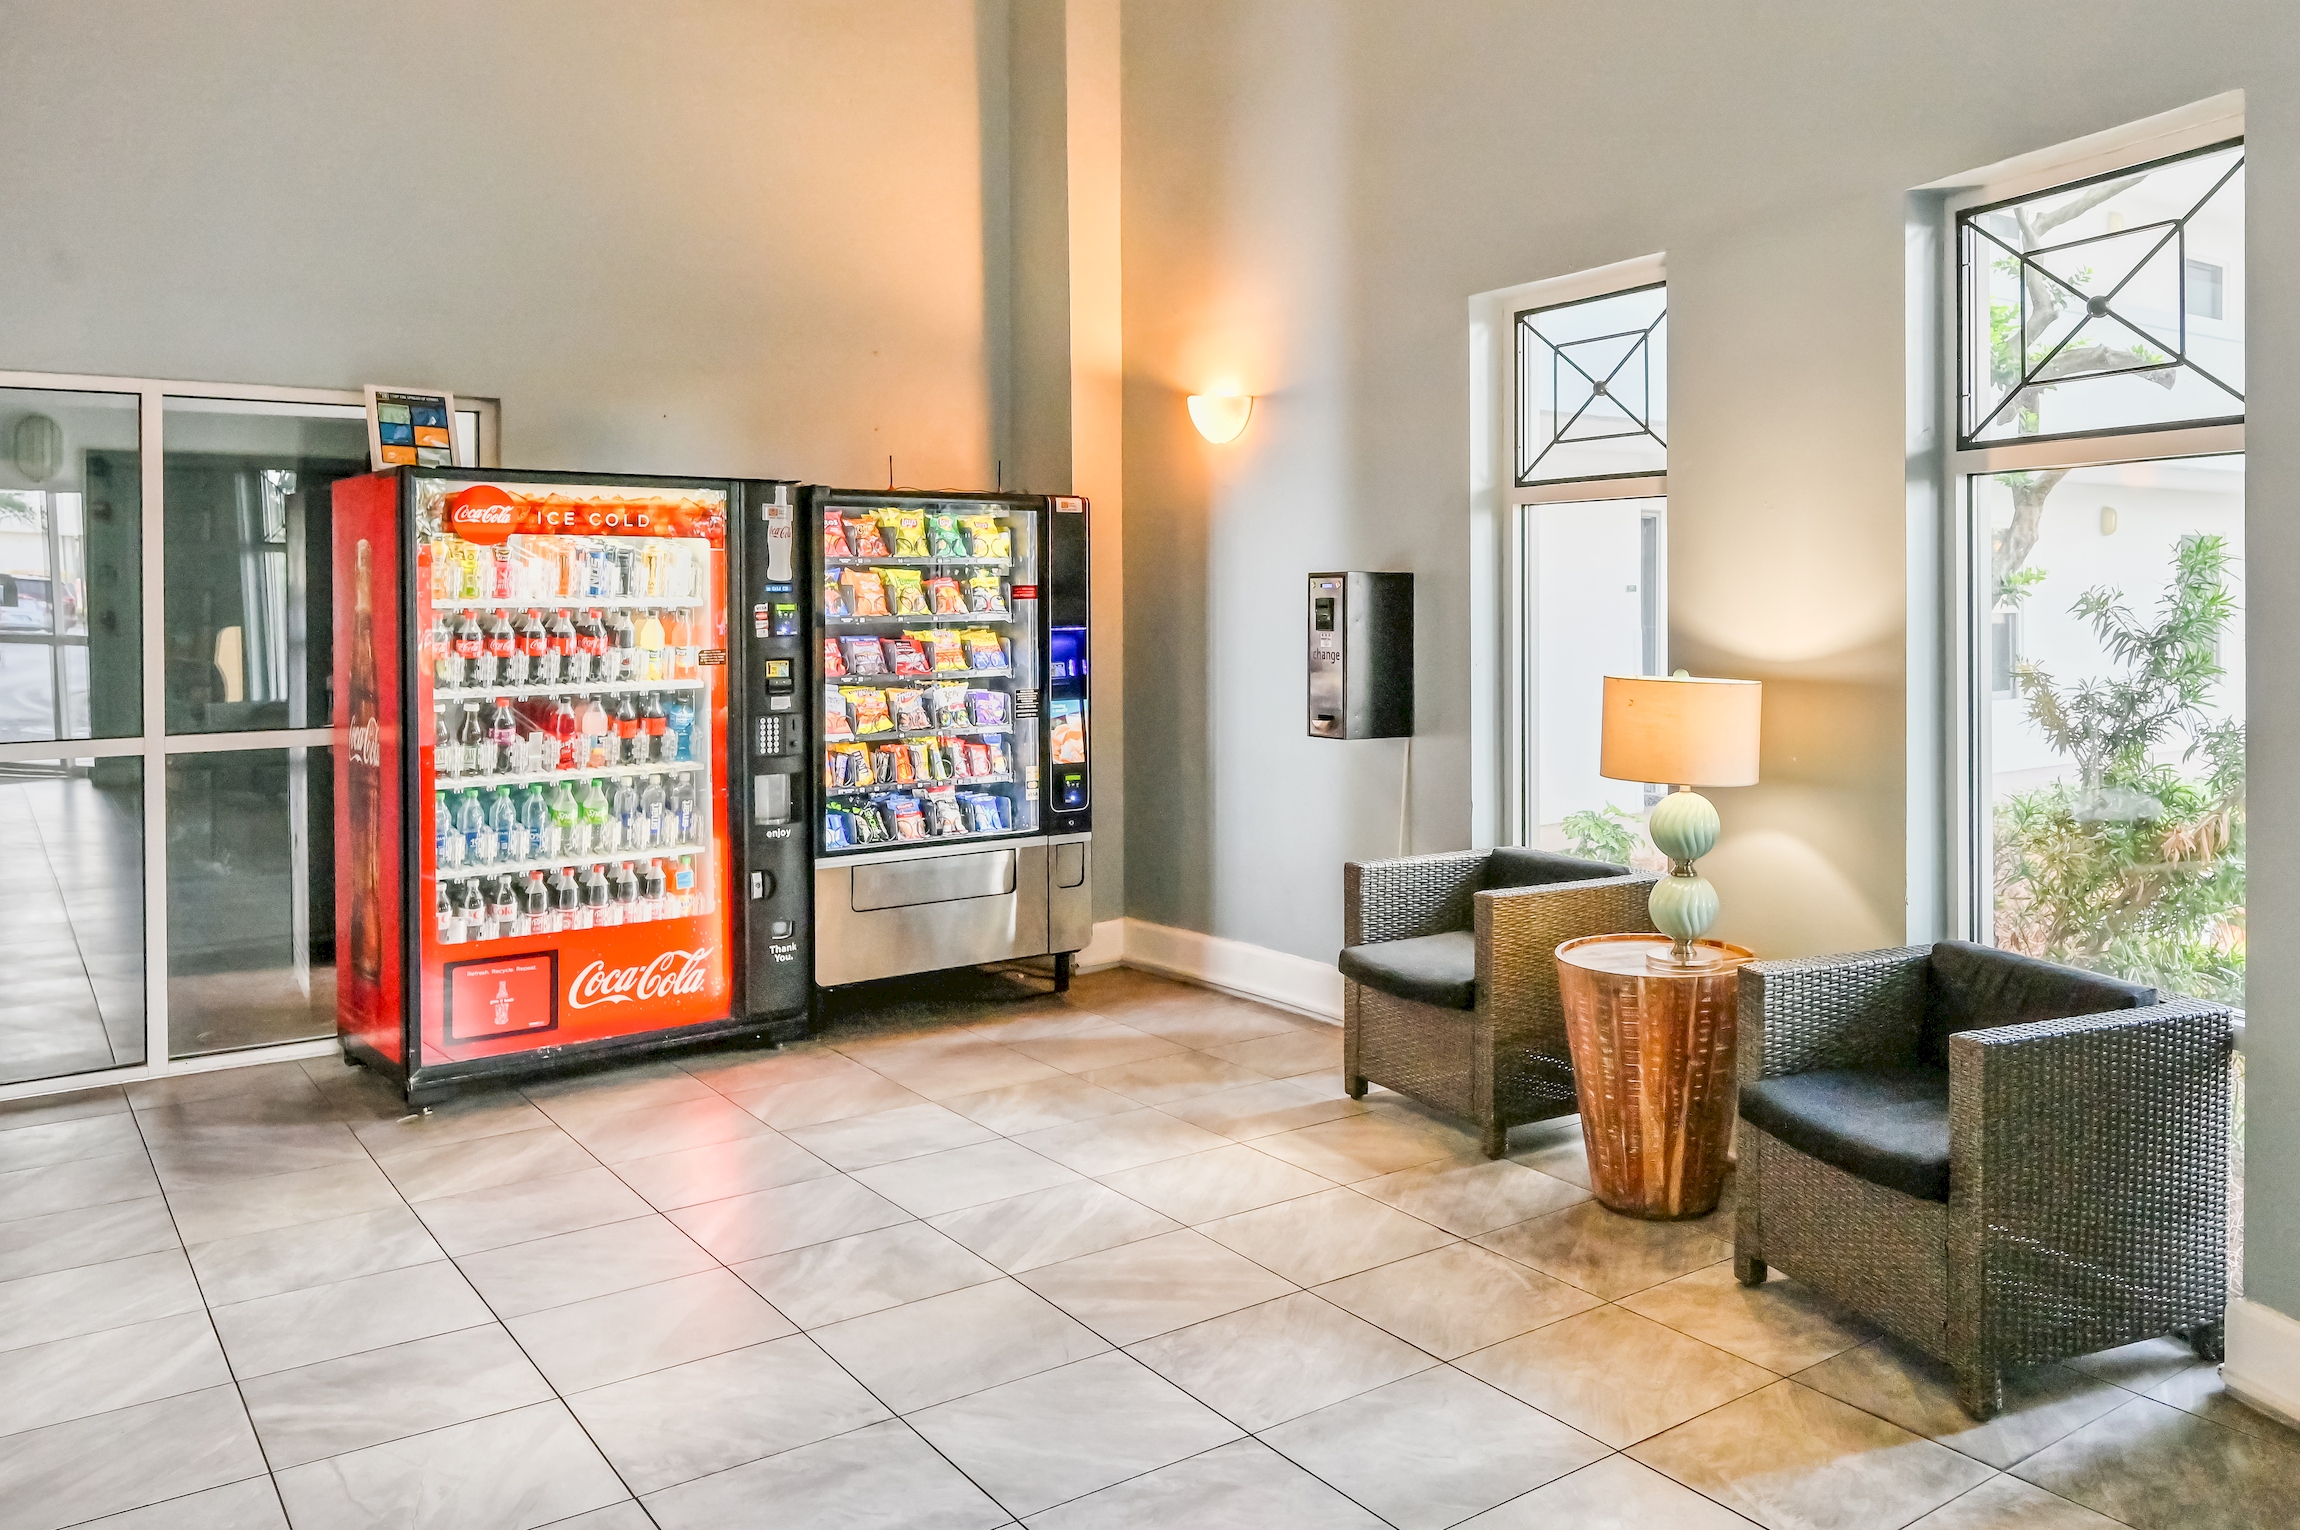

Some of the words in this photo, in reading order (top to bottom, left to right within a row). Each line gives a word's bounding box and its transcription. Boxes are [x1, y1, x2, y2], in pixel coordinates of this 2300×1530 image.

[454, 504, 514, 524] Coca-Cola
[537, 511, 575, 526] ICE
[588, 513, 650, 528] COLD
[1312, 647, 1341, 664] change
[766, 828, 791, 838] enjoy
[768, 942, 797, 955] Thank
[774, 953, 794, 963] You.
[568, 946, 715, 1010] Coca-Cola
